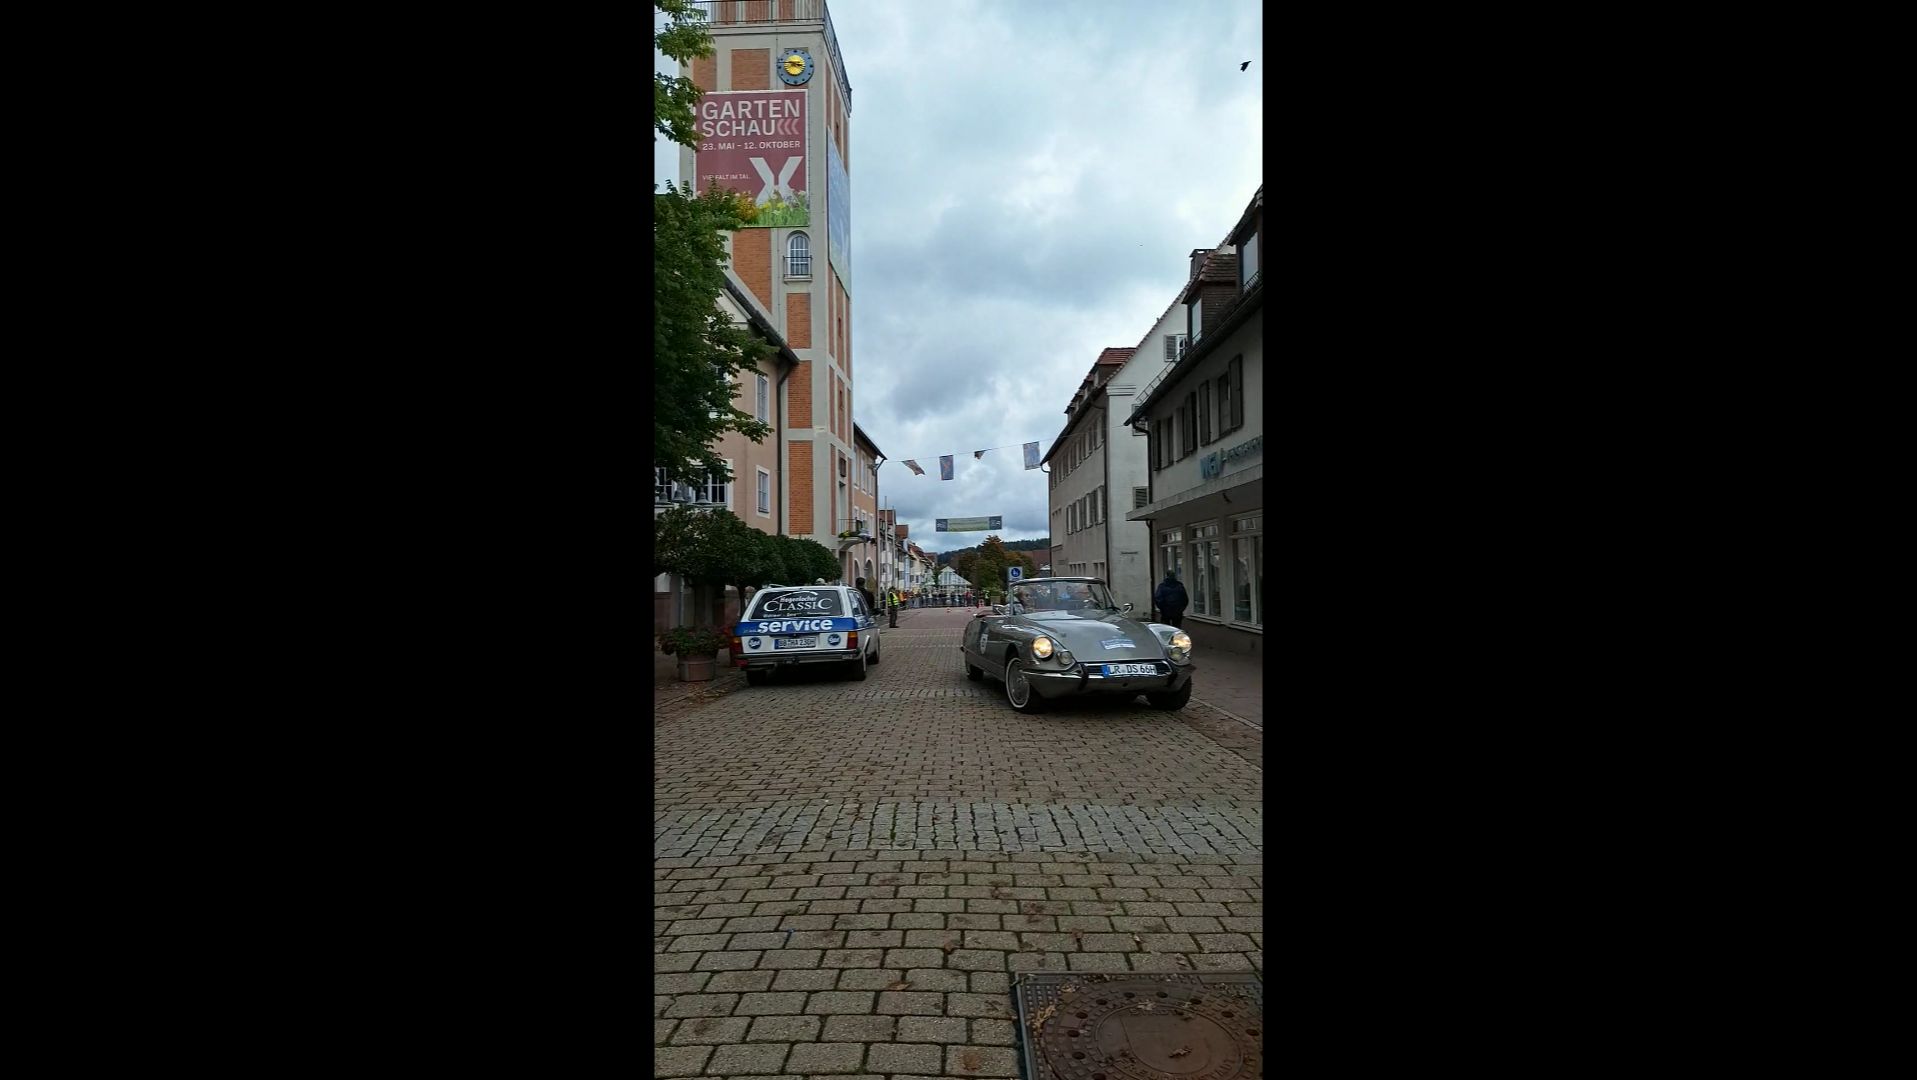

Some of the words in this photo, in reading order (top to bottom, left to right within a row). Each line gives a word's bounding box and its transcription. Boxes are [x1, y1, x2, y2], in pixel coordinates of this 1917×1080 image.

[702, 99, 800, 120] GARTEN
[702, 120, 776, 137] SCHAU
[702, 143, 716, 151] 23.
[718, 142, 735, 150] MAI
[744, 141, 757, 150] 12.
[759, 140, 801, 149] OKTOBER
[763, 598, 833, 612] CLASSIC
[758, 619, 834, 634] service
[1109, 665, 1121, 675] LR
[1127, 664, 1137, 674] DS
[1140, 664, 1157, 674] 66H
